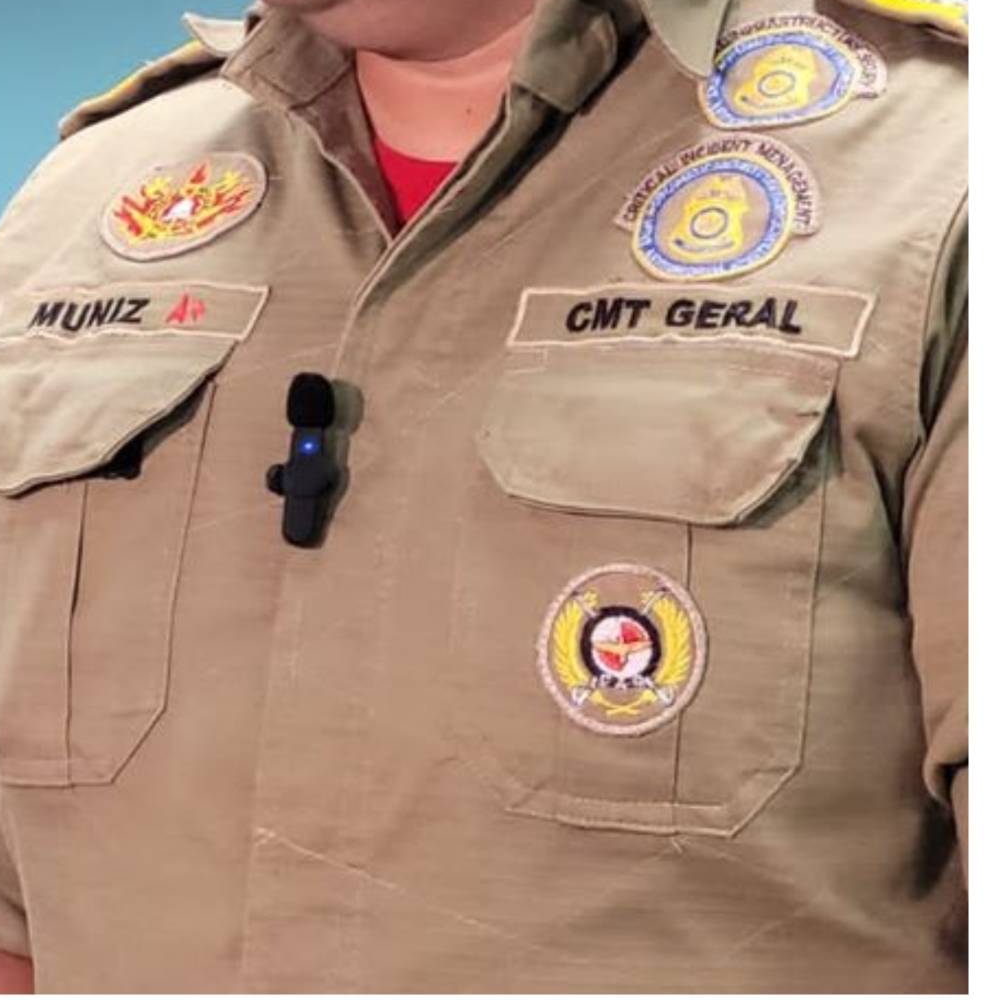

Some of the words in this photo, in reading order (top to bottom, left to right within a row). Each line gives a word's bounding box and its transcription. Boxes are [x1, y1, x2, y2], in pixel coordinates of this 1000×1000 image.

[622, 164, 677, 223] CRITICAL
[679, 138, 752, 167] INCIDENT
[28, 296, 150, 332] MUNIZ
[565, 297, 652, 332] CMT
[665, 297, 804, 334] GERAL
